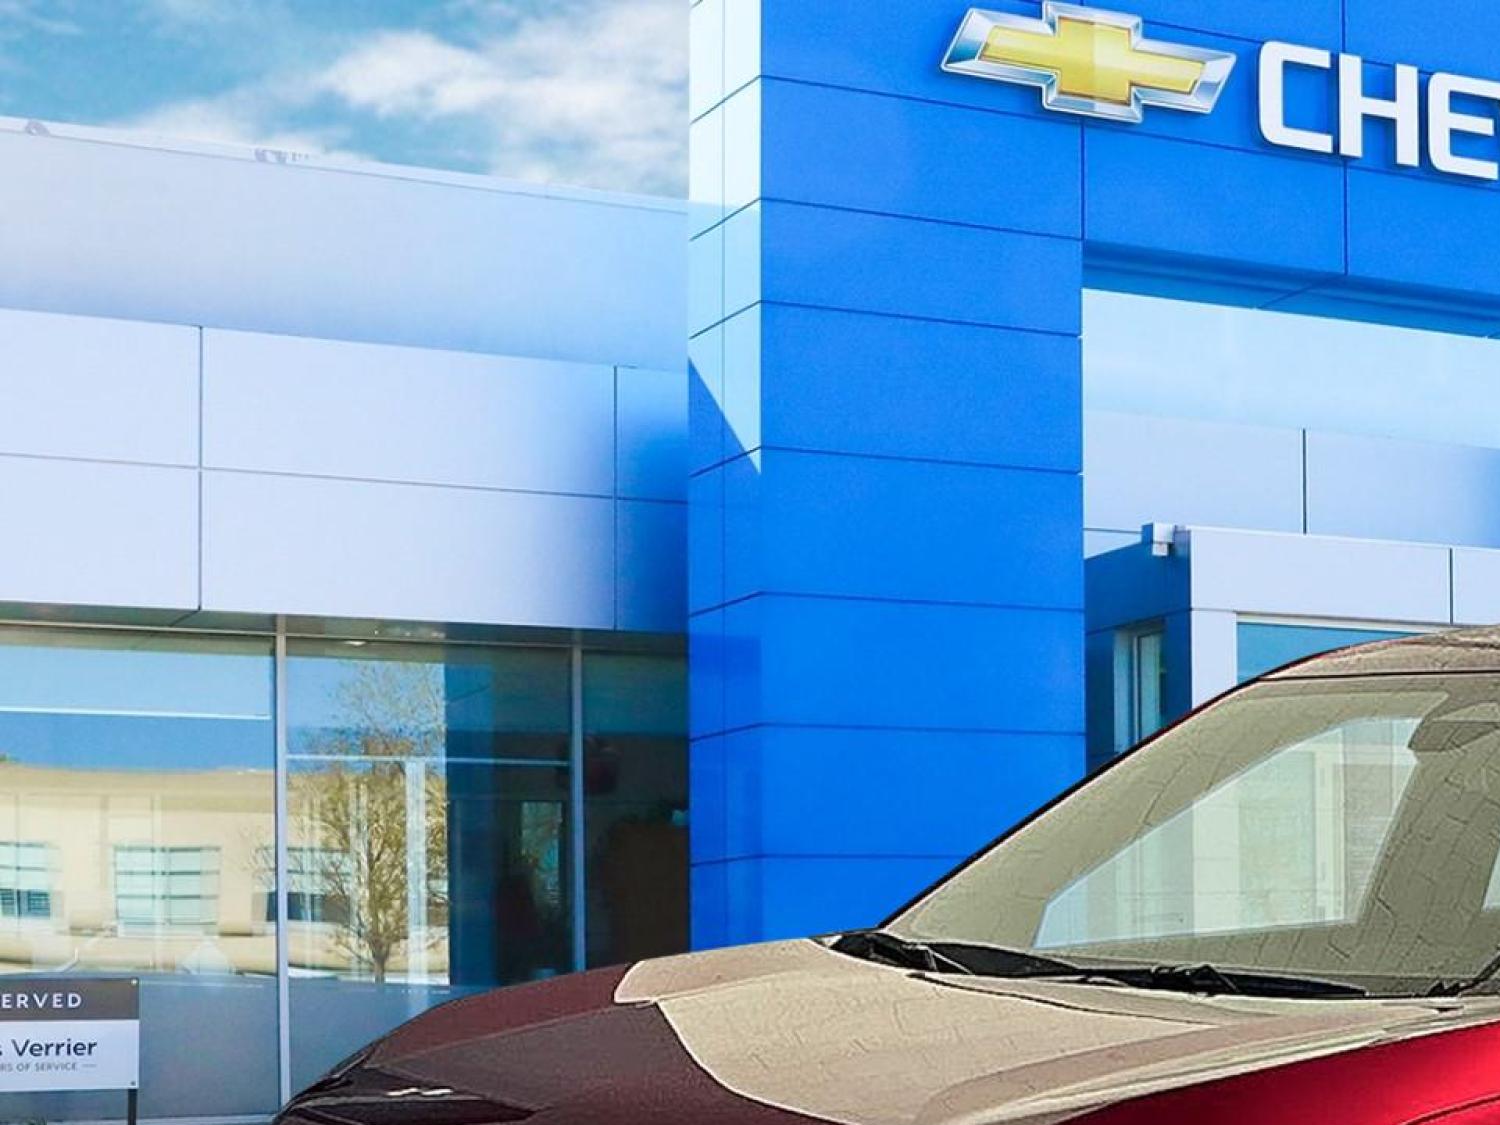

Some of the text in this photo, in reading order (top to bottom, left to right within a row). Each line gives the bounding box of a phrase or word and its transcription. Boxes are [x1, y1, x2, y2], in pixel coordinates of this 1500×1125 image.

[2, 993, 82, 1009] ERVED
[11, 1038, 98, 1057] Verrier
[16, 1062, 30, 1072] OF
[35, 1062, 77, 1072] SERVICE
